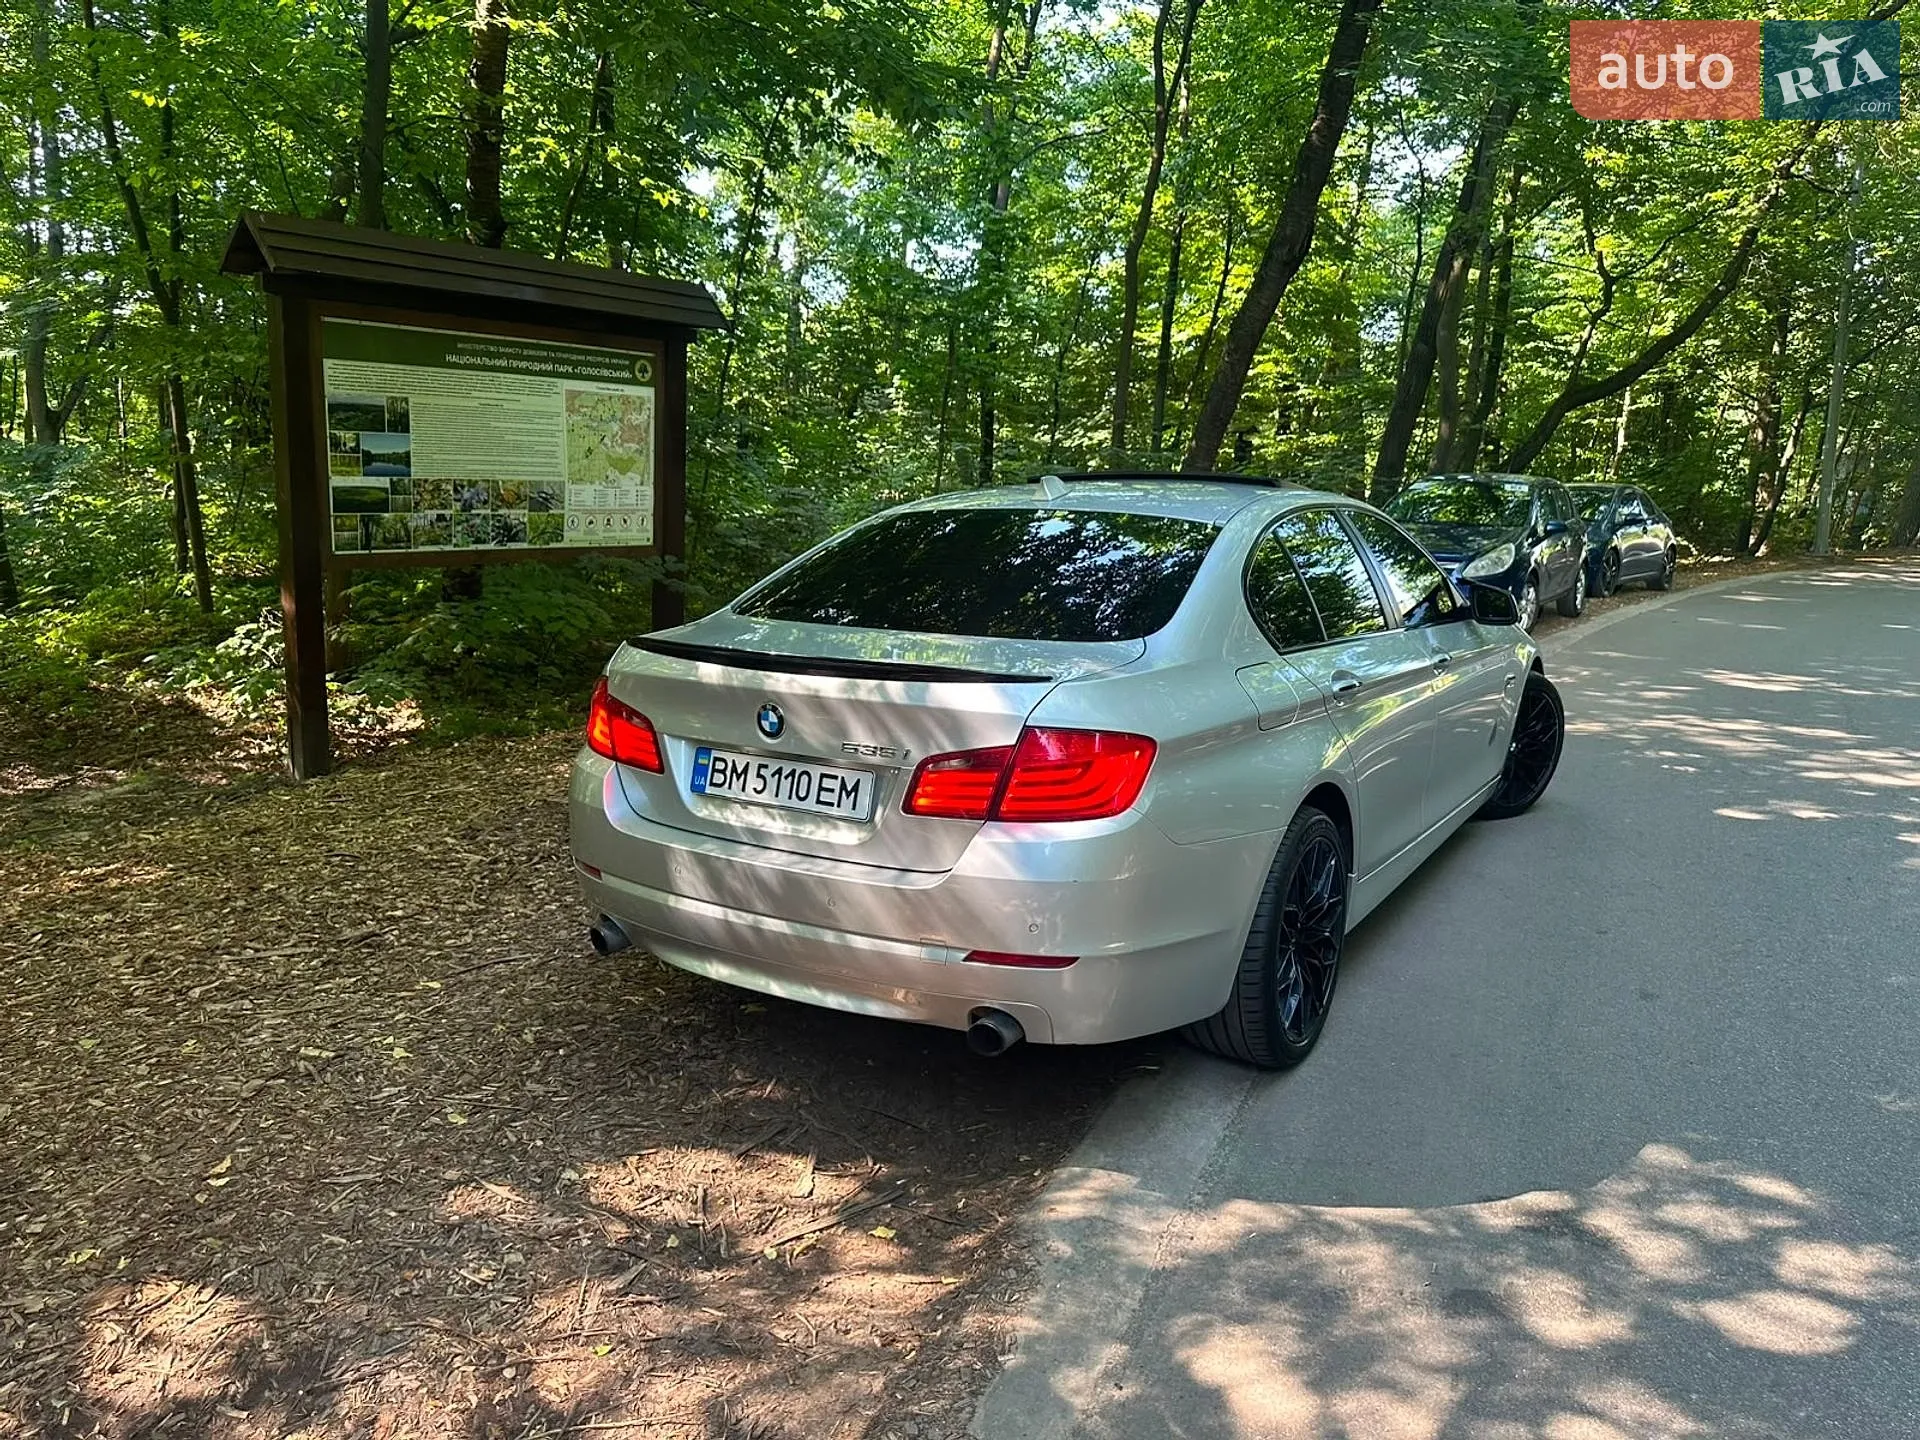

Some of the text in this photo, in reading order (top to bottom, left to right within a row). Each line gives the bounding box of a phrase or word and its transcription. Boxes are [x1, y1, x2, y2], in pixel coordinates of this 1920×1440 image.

[446, 353, 508, 367] НАЦІОНАЛЬНИЙ
[509, 359, 553, 372] ПРИРОДНИЙ
[555, 364, 573, 373] ПАРК
[694, 776, 706, 786] UA
[709, 756, 861, 811] BM 5110 EM
